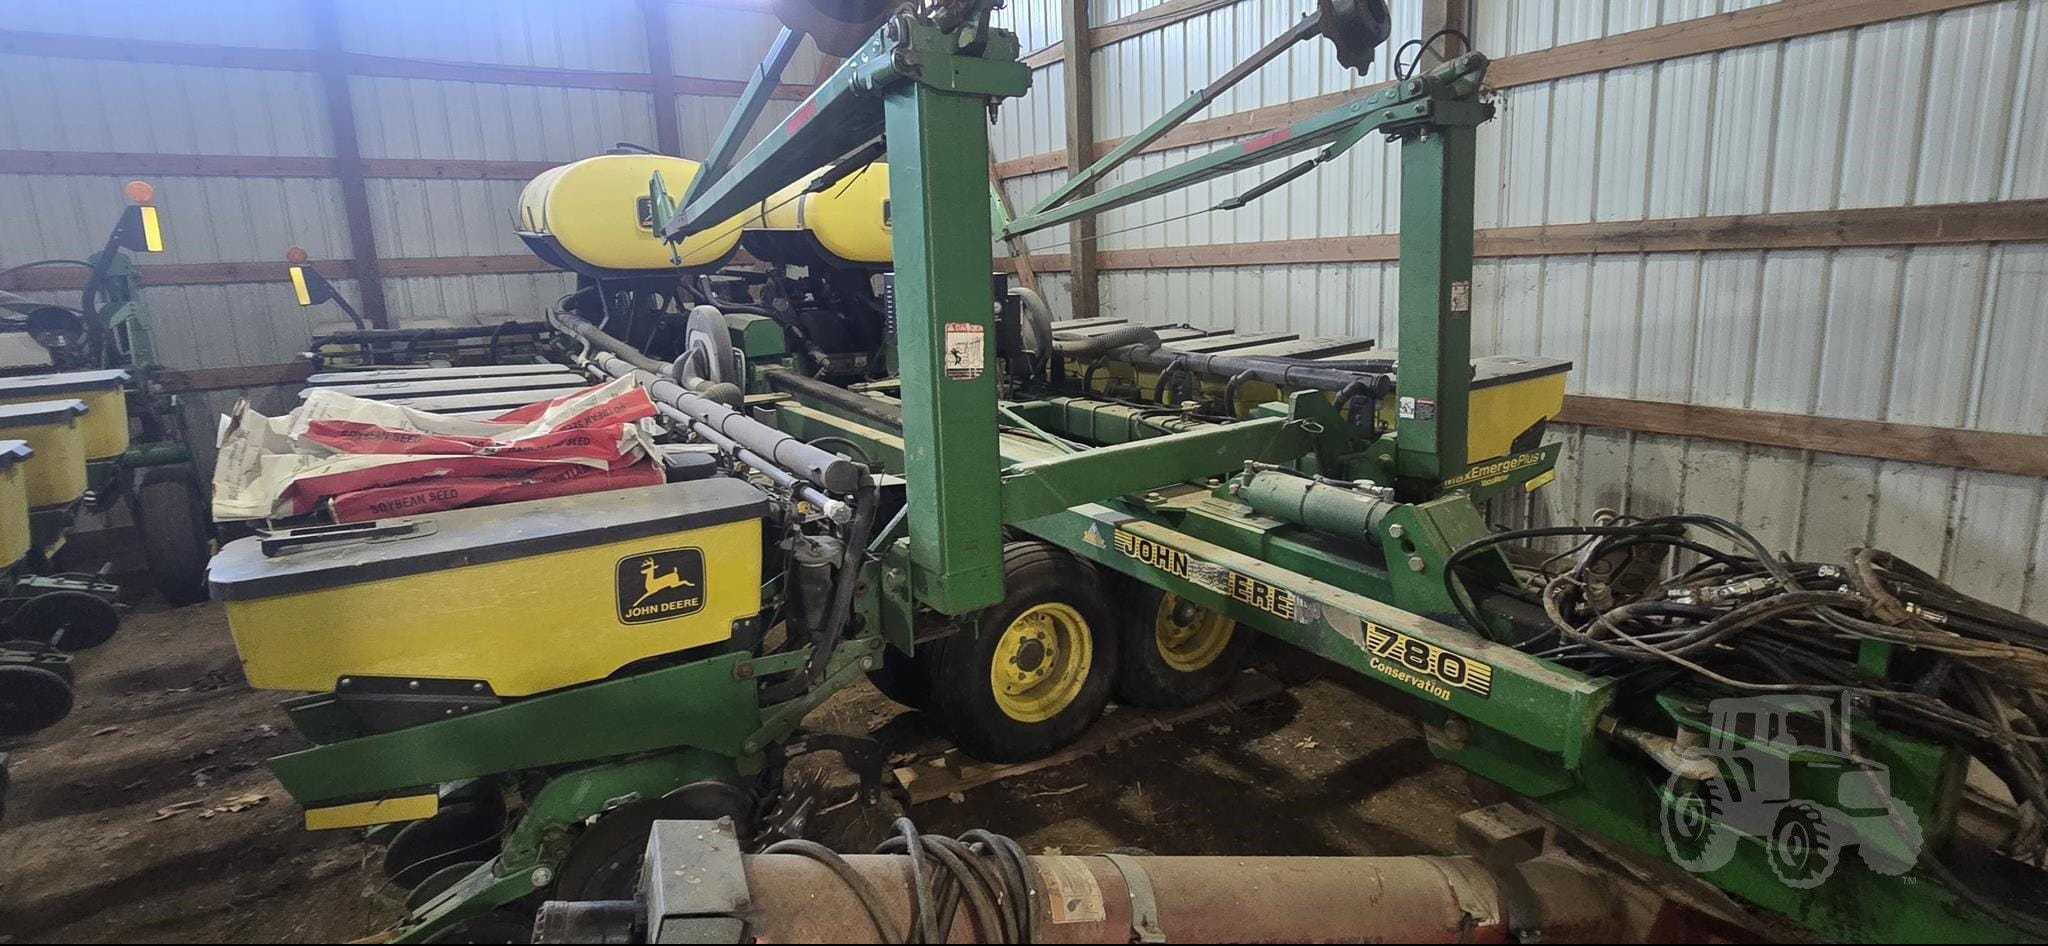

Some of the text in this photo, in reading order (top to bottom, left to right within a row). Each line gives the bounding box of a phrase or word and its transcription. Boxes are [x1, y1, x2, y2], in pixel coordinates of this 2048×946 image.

[565, 436, 590, 446] SEED
[369, 488, 458, 514] SOYBEAN SEED
[1123, 535, 1191, 579] JOHN
[625, 597, 699, 618] JOHN DEERE
[1372, 623, 1467, 687] 780
[1369, 657, 1452, 701] Conservation
